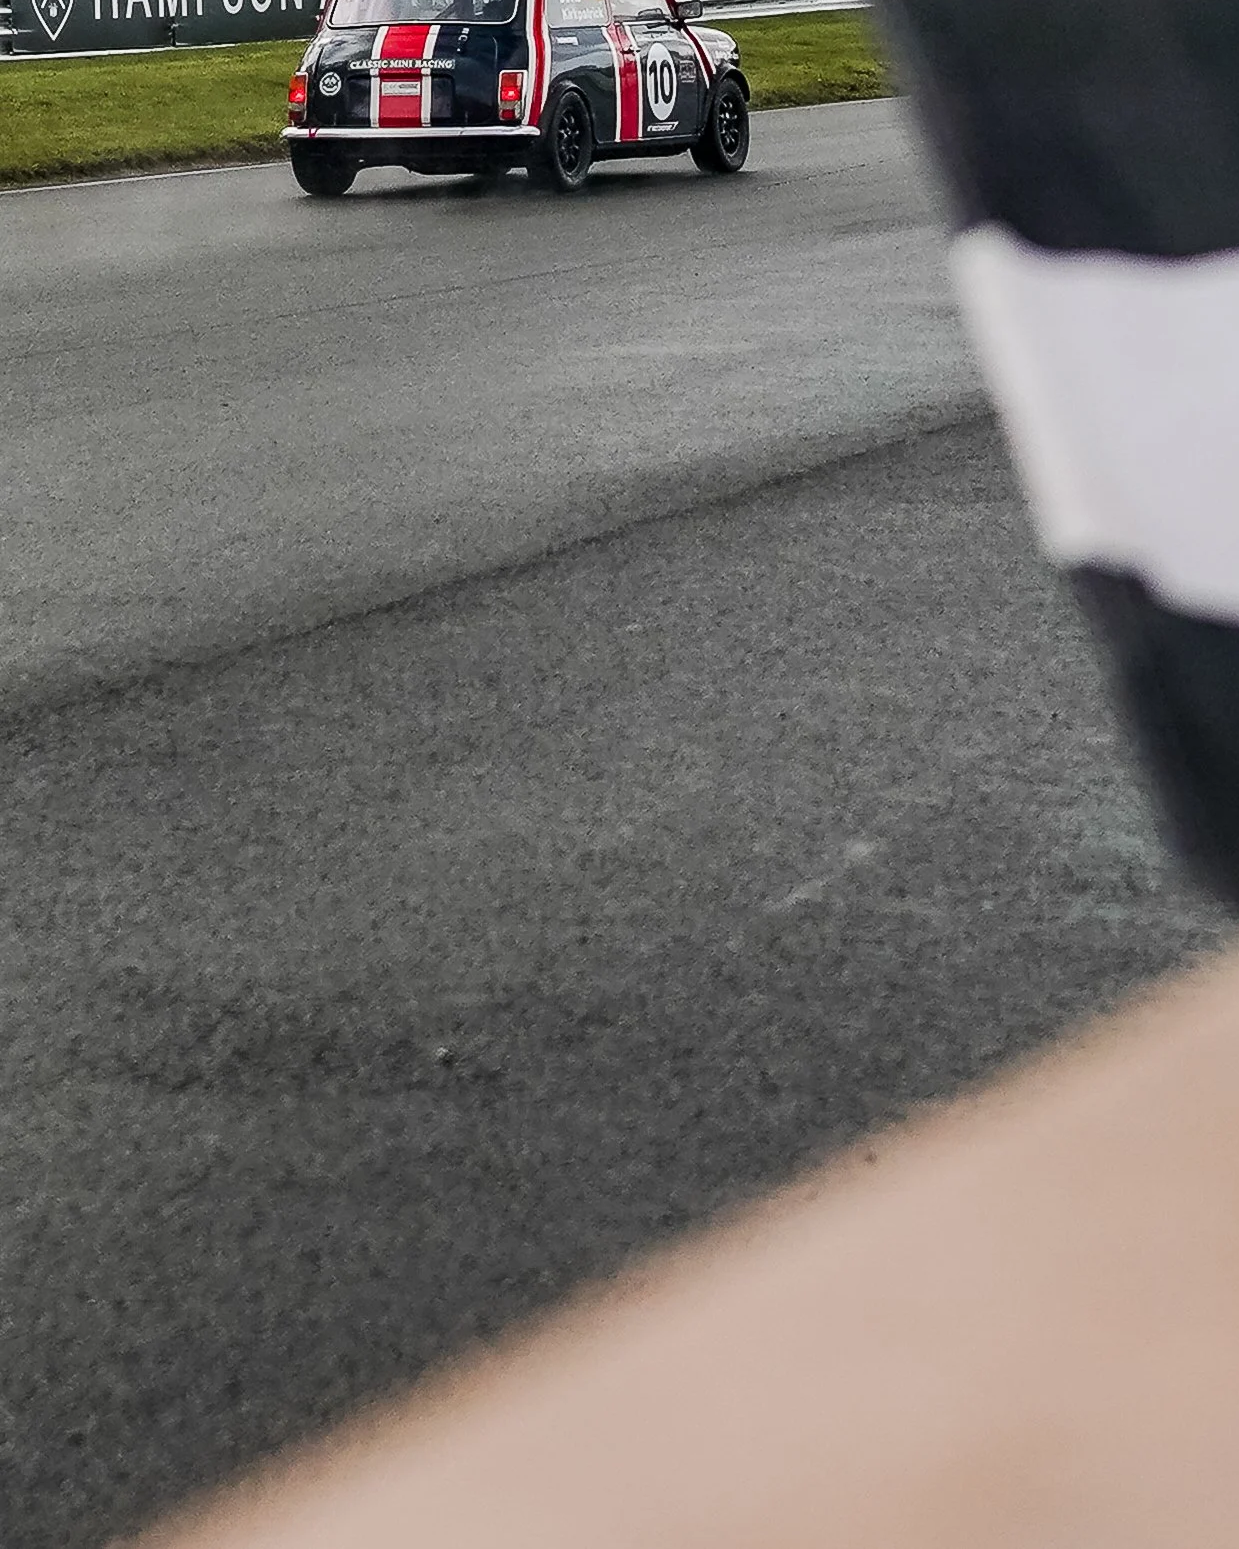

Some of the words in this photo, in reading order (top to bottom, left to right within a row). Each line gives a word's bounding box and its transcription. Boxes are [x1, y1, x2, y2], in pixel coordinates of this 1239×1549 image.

[561, 6, 605, 22] Kirkpatrick
[349, 59, 389, 70] CLASSIC
[390, 59, 413, 69] MINI
[415, 59, 454, 69] RACING
[648, 59, 674, 105] 10
